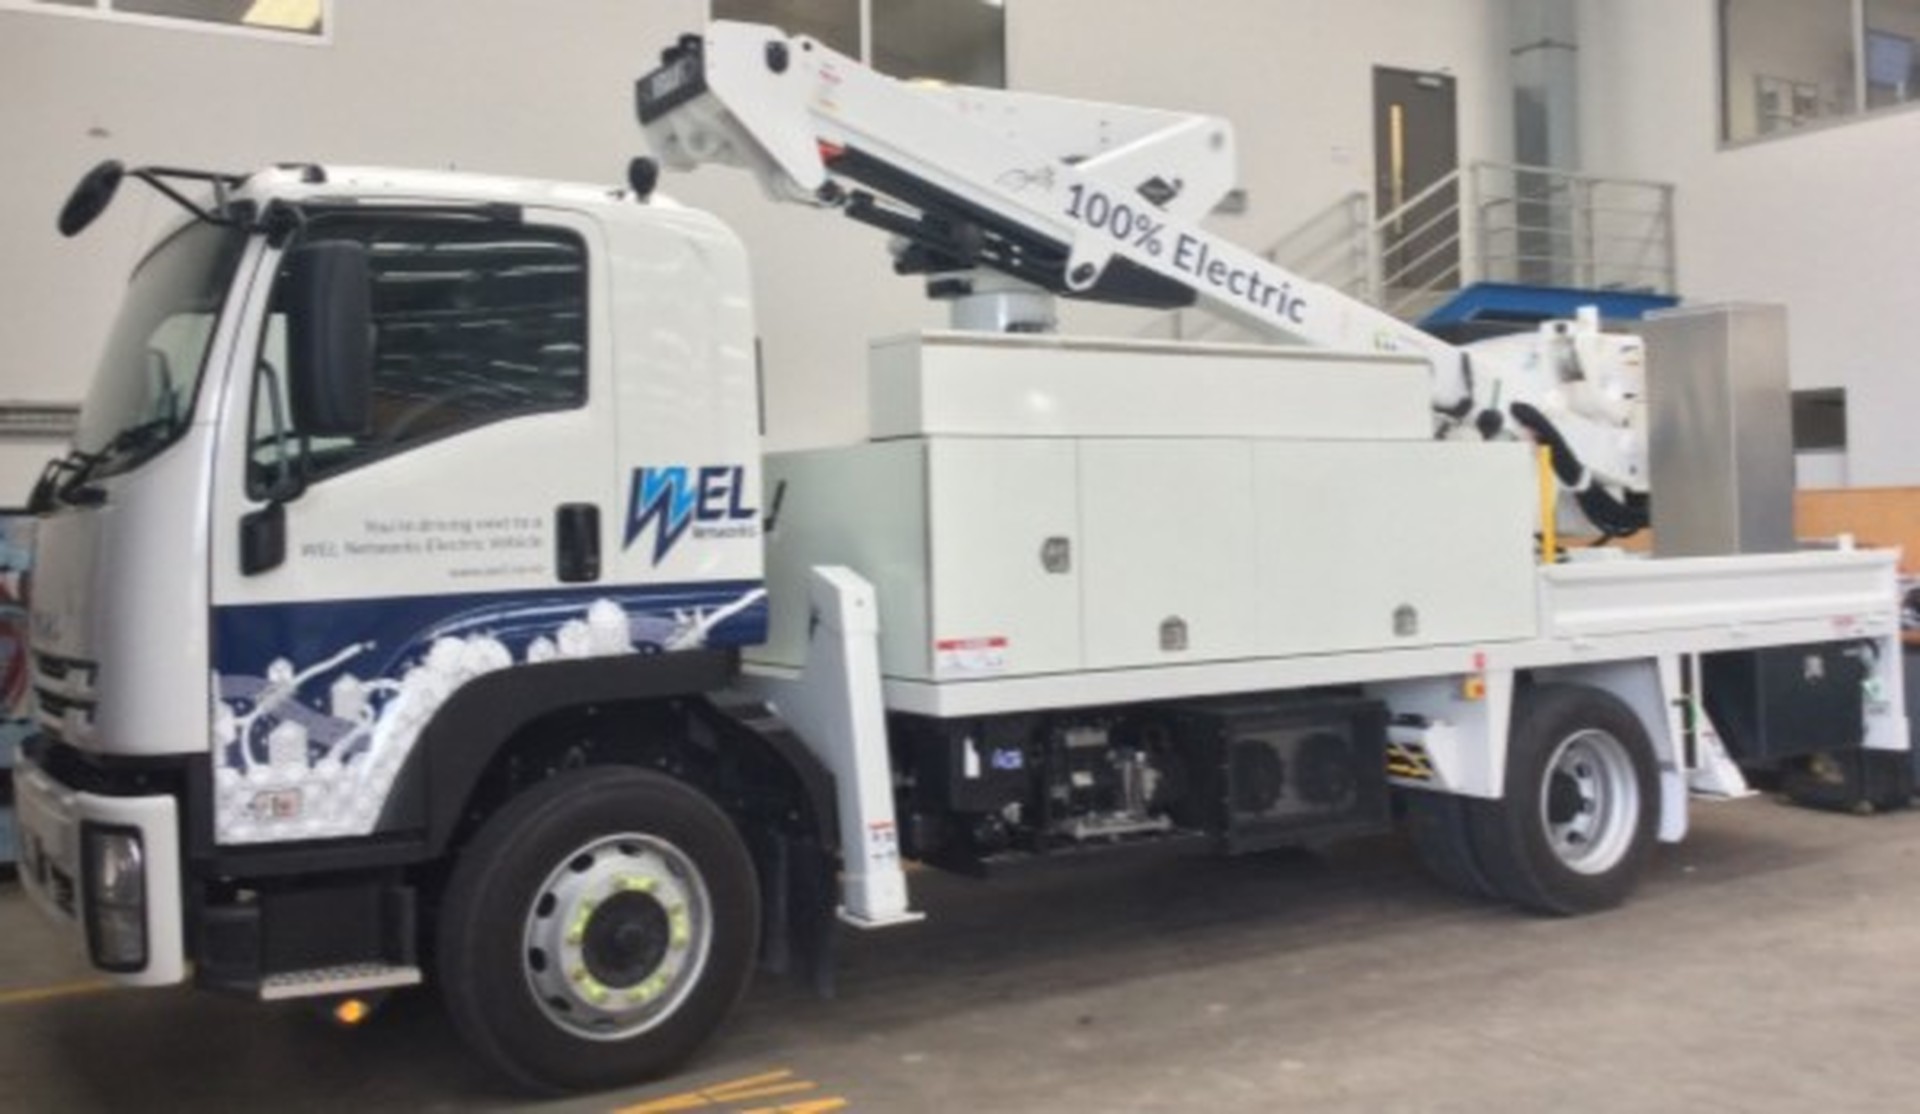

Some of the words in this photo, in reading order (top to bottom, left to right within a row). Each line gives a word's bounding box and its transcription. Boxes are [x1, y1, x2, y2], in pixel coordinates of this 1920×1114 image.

[1064, 183, 1165, 257] 100%
[1172, 232, 1308, 324] Electric
[621, 466, 757, 568] WEL
